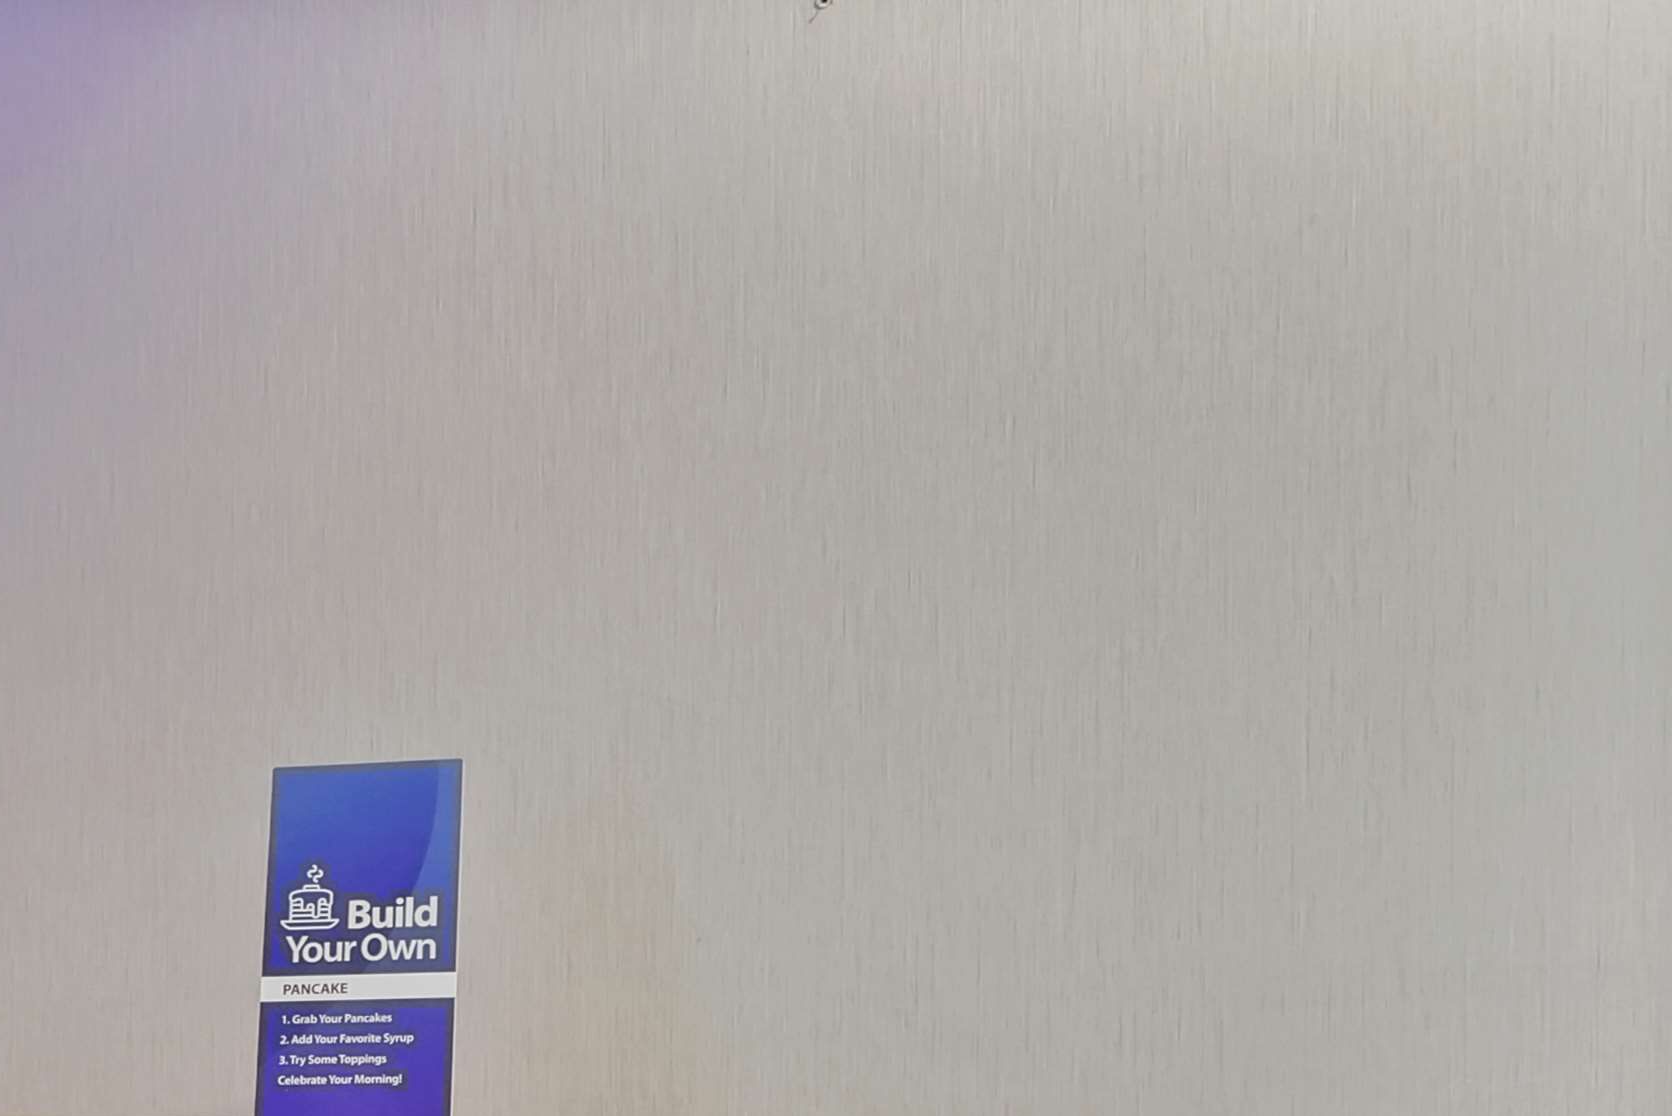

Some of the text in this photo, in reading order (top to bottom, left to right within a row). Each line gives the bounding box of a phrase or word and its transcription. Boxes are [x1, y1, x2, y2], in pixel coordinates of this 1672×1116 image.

[347, 895, 439, 930] Build
[285, 932, 437, 964] Your Own
[282, 982, 349, 995] PANCAKE
[281, 1012, 392, 1025] 1. Grab Your Pancakes
[280, 1032, 415, 1045] 2. Add Your Favorite Syrup
[279, 1053, 387, 1067] 3. Try Some Toppings
[277, 1073, 403, 1087] Celebrate Your Morning!
